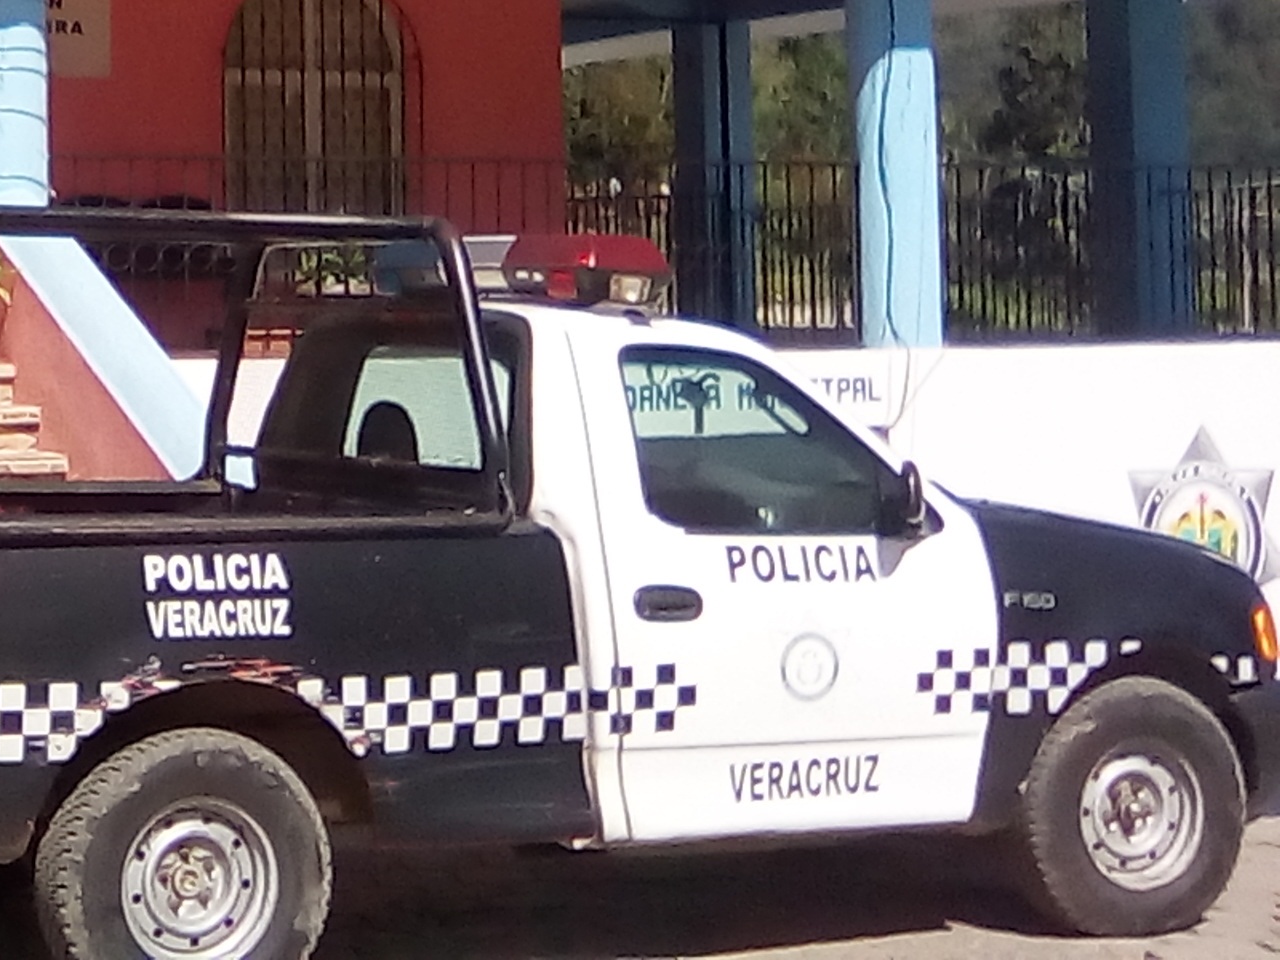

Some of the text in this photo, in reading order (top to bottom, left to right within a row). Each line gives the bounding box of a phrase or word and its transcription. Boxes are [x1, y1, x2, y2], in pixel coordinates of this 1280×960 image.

[143, 553, 288, 592] POLICIA
[725, 545, 877, 582] POLICIA
[147, 598, 292, 639] VERACRUZ
[729, 754, 881, 803] VERACRUZ
